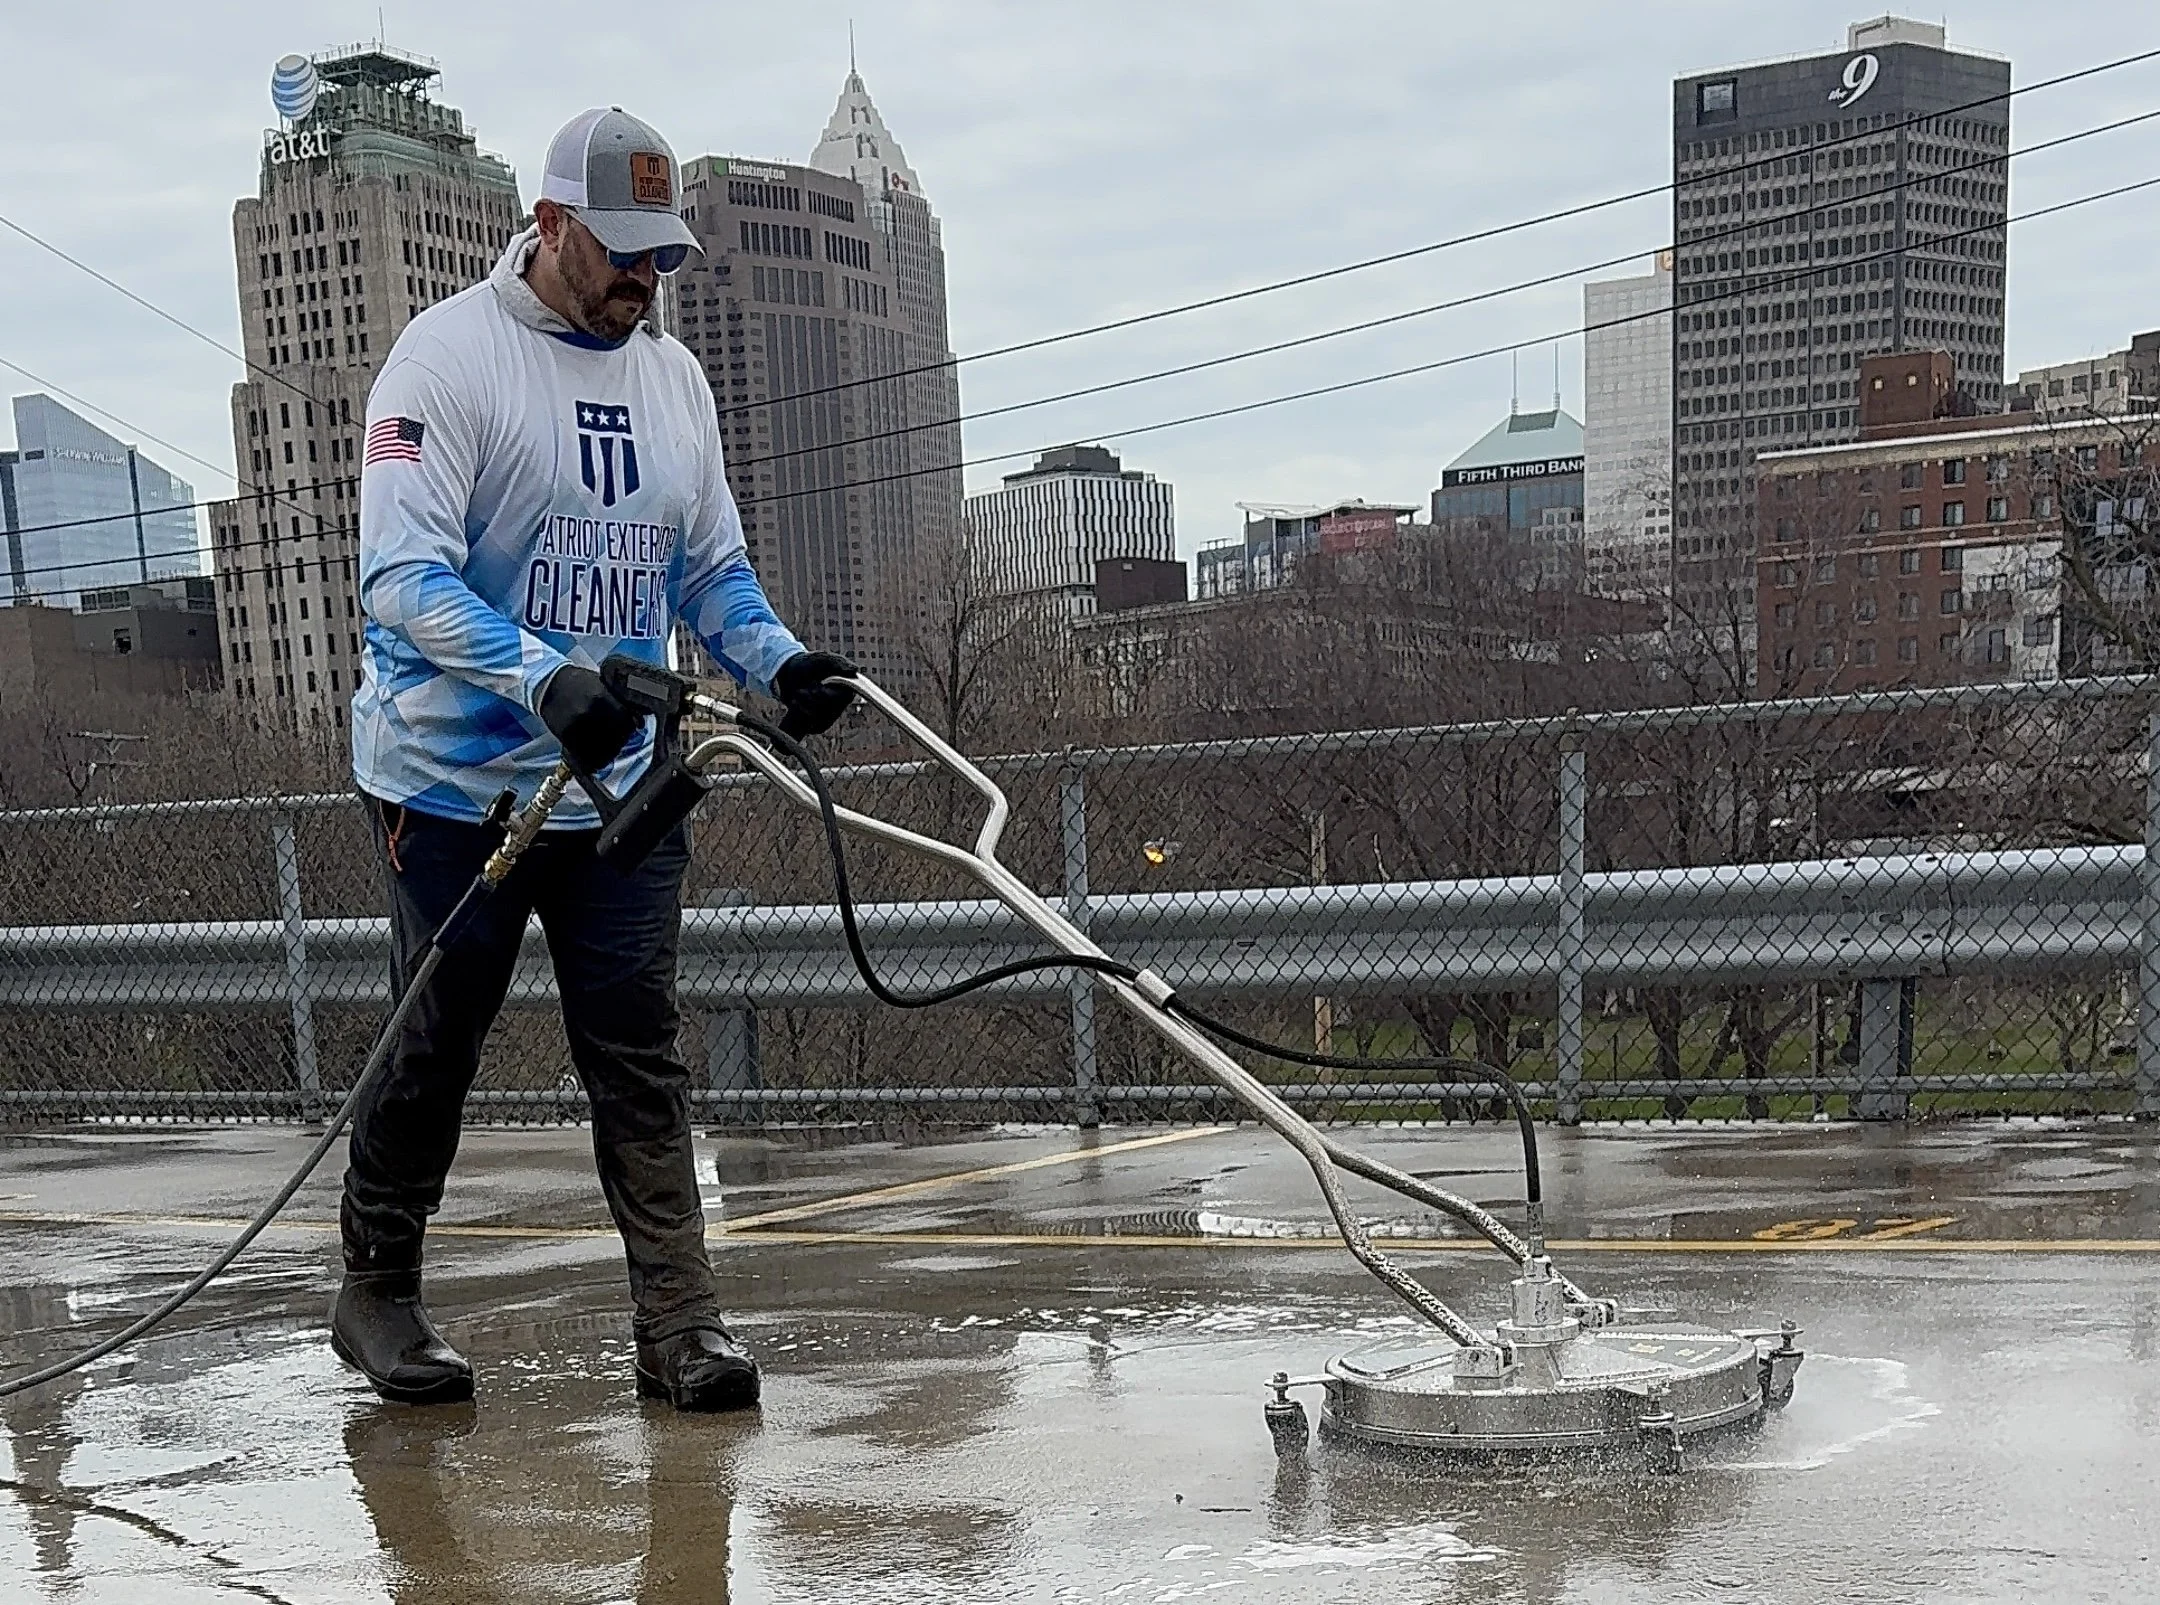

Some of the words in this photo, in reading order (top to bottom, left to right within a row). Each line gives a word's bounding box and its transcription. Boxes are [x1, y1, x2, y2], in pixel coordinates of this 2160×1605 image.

[1838, 54, 1879, 108] 9
[271, 122, 330, 165] at&t
[728, 160, 786, 182] Huntington
[1458, 468, 1497, 483] FIFTH
[1500, 463, 1545, 479] THIRD
